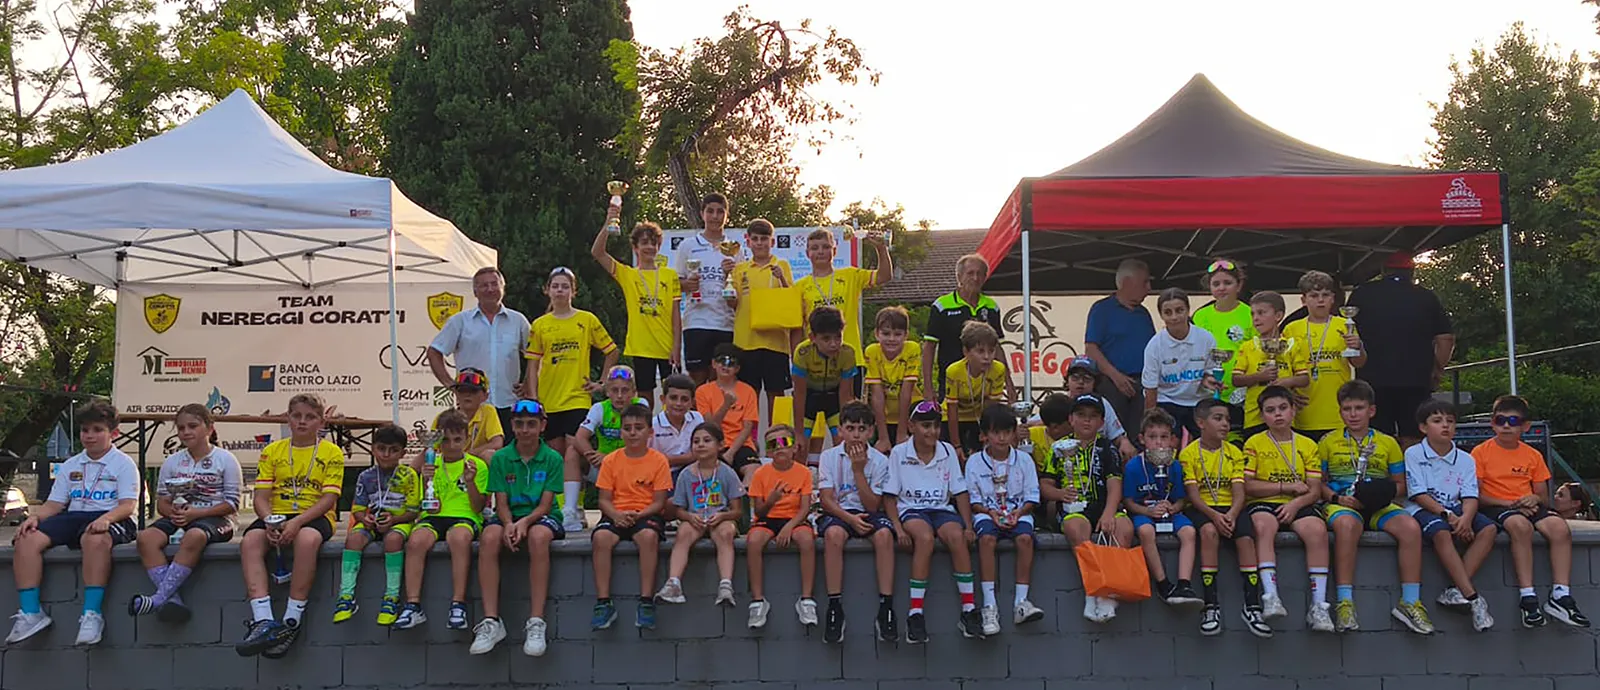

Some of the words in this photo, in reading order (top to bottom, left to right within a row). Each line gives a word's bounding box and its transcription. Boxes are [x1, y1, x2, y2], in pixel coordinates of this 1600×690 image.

[278, 295, 334, 308] TEAM
[201, 311, 304, 325] NEREGGI
[280, 364, 320, 373] BANCA
[279, 375, 324, 385] CENTRO
[327, 375, 361, 385] LAZIO
[126, 405, 142, 413] AIR
